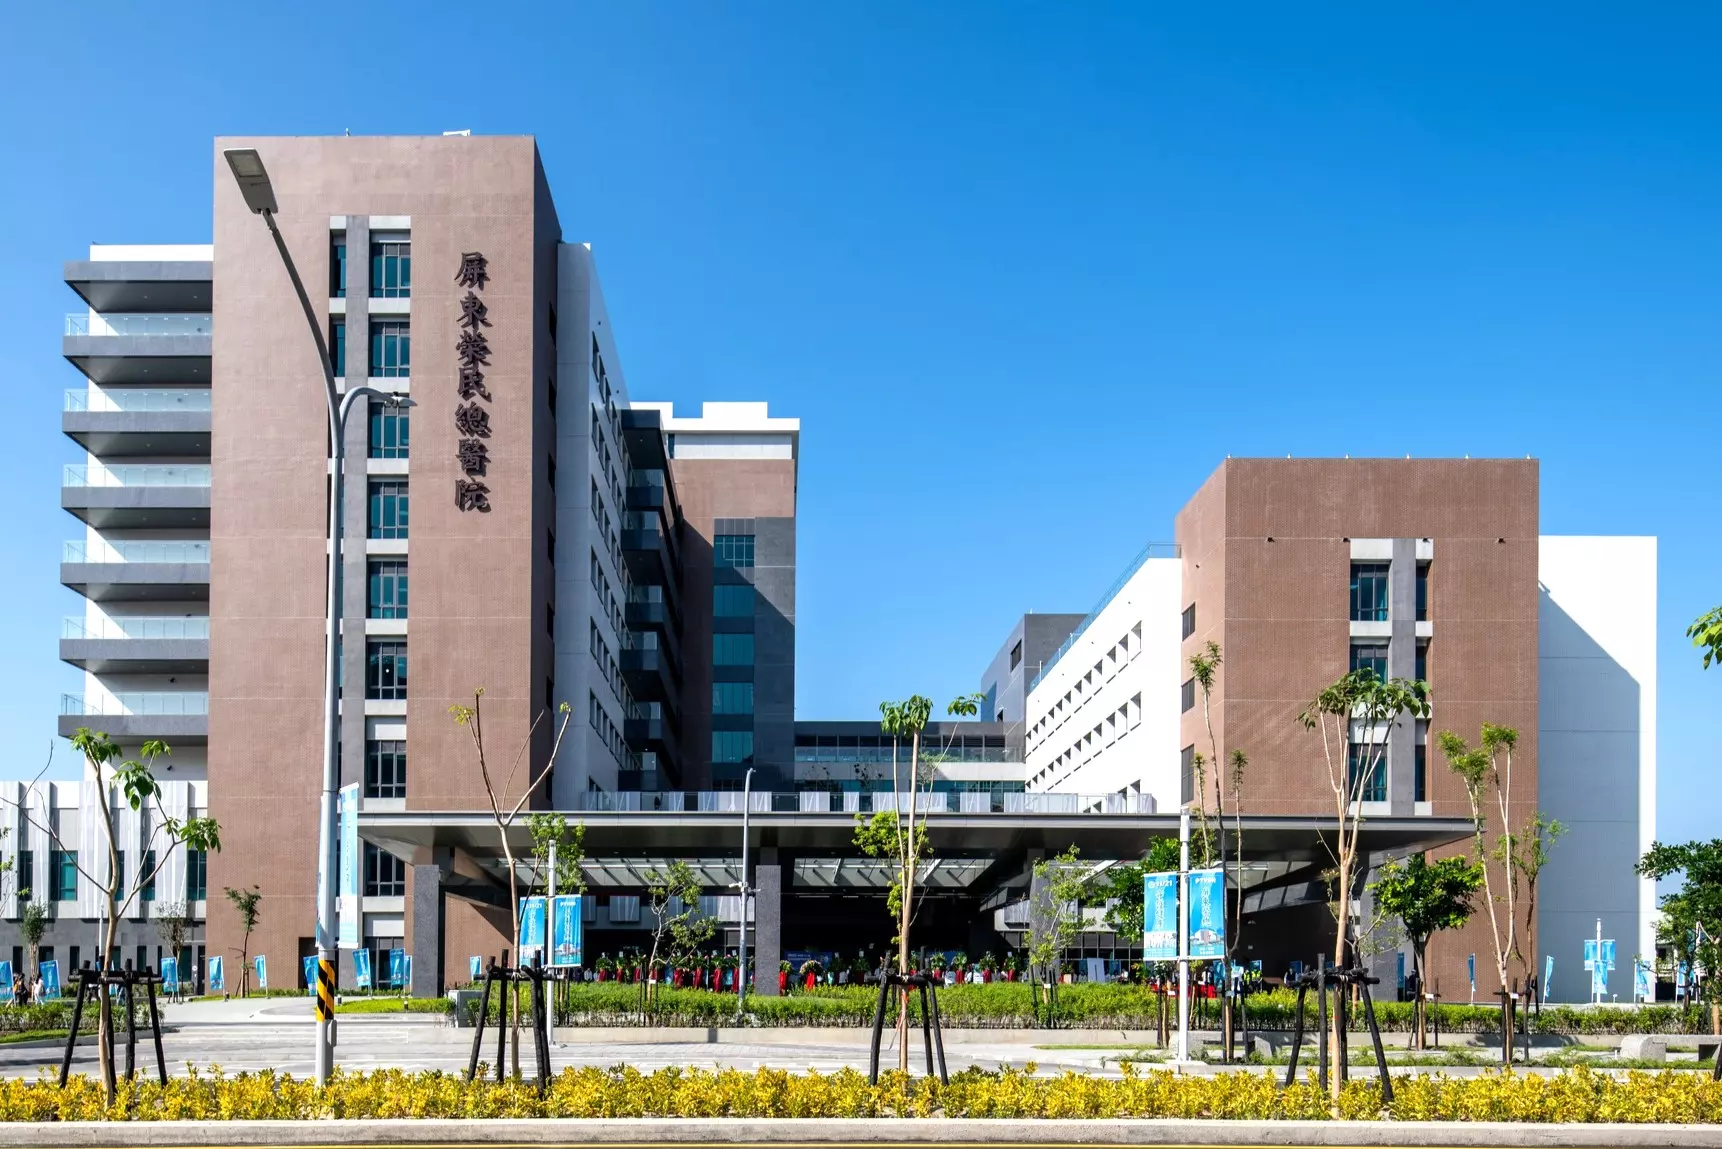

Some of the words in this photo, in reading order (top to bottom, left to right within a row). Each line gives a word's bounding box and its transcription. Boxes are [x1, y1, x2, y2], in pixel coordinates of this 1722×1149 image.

[454, 251, 491, 513] 屏東榮民總醫院
